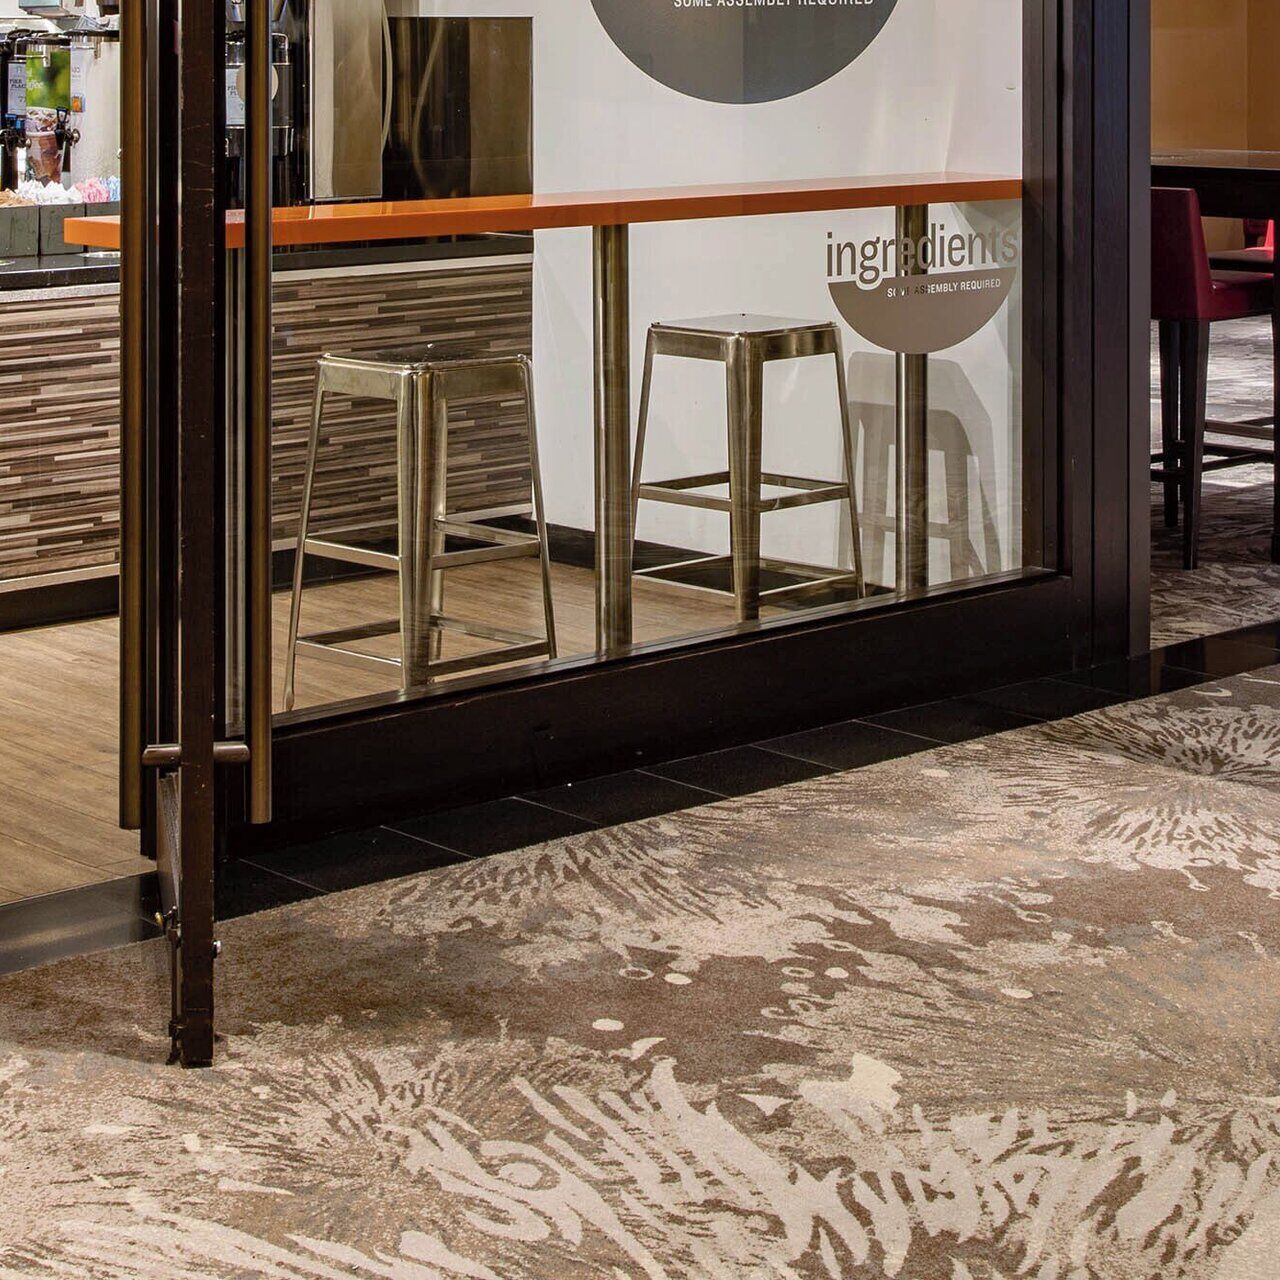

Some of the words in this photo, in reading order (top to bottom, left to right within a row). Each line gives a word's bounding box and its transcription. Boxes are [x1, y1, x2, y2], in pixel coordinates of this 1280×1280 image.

[826, 222, 1019, 285] ingredients
[914, 281, 959, 296] ASSEMBLY
[960, 278, 1001, 292] REQUIRED
